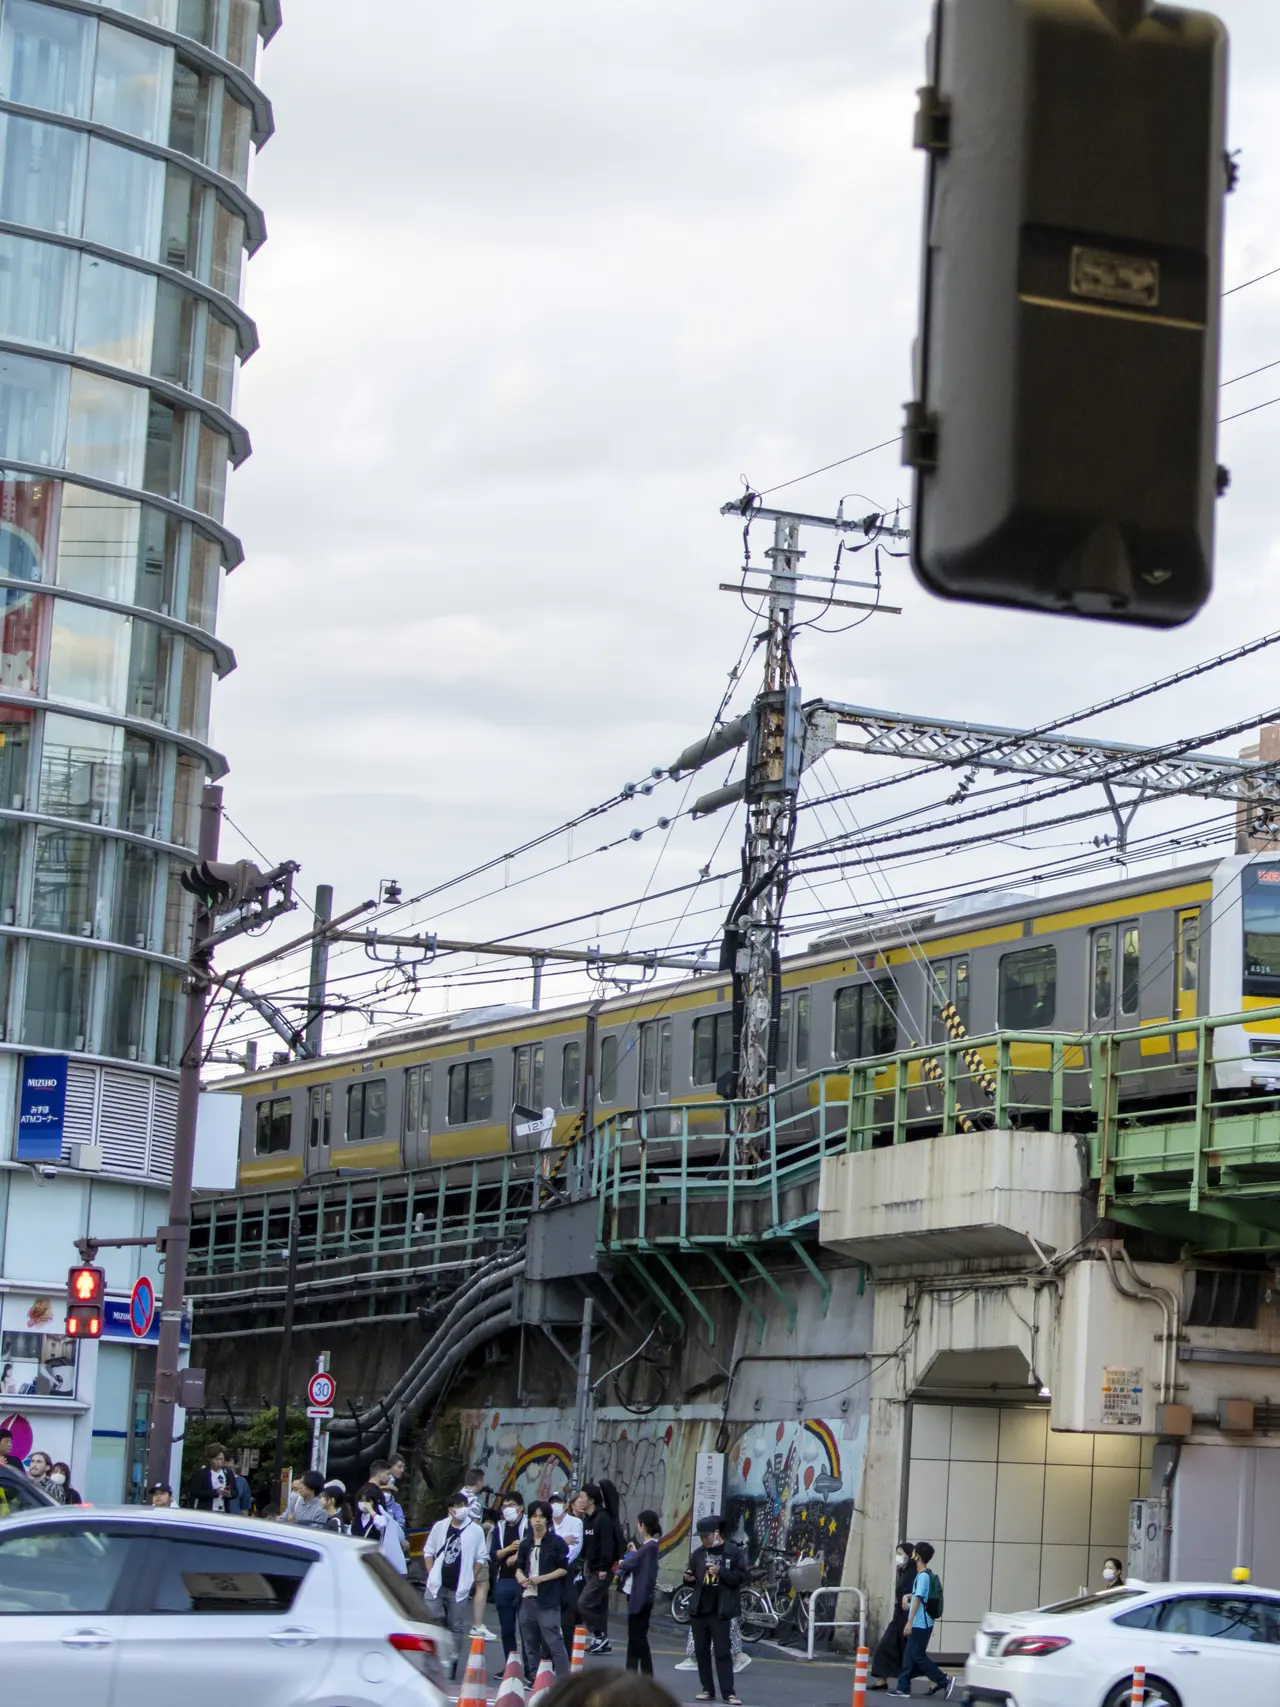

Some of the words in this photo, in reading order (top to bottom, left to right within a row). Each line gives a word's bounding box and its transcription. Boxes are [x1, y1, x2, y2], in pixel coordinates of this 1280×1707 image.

[27, 1079, 57, 1087] MIZUHO
[30, 1106, 50, 1114] みずほ
[20, 1115, 58, 1123] ATMコーナー
[315, 1382, 329, 1397] 30
